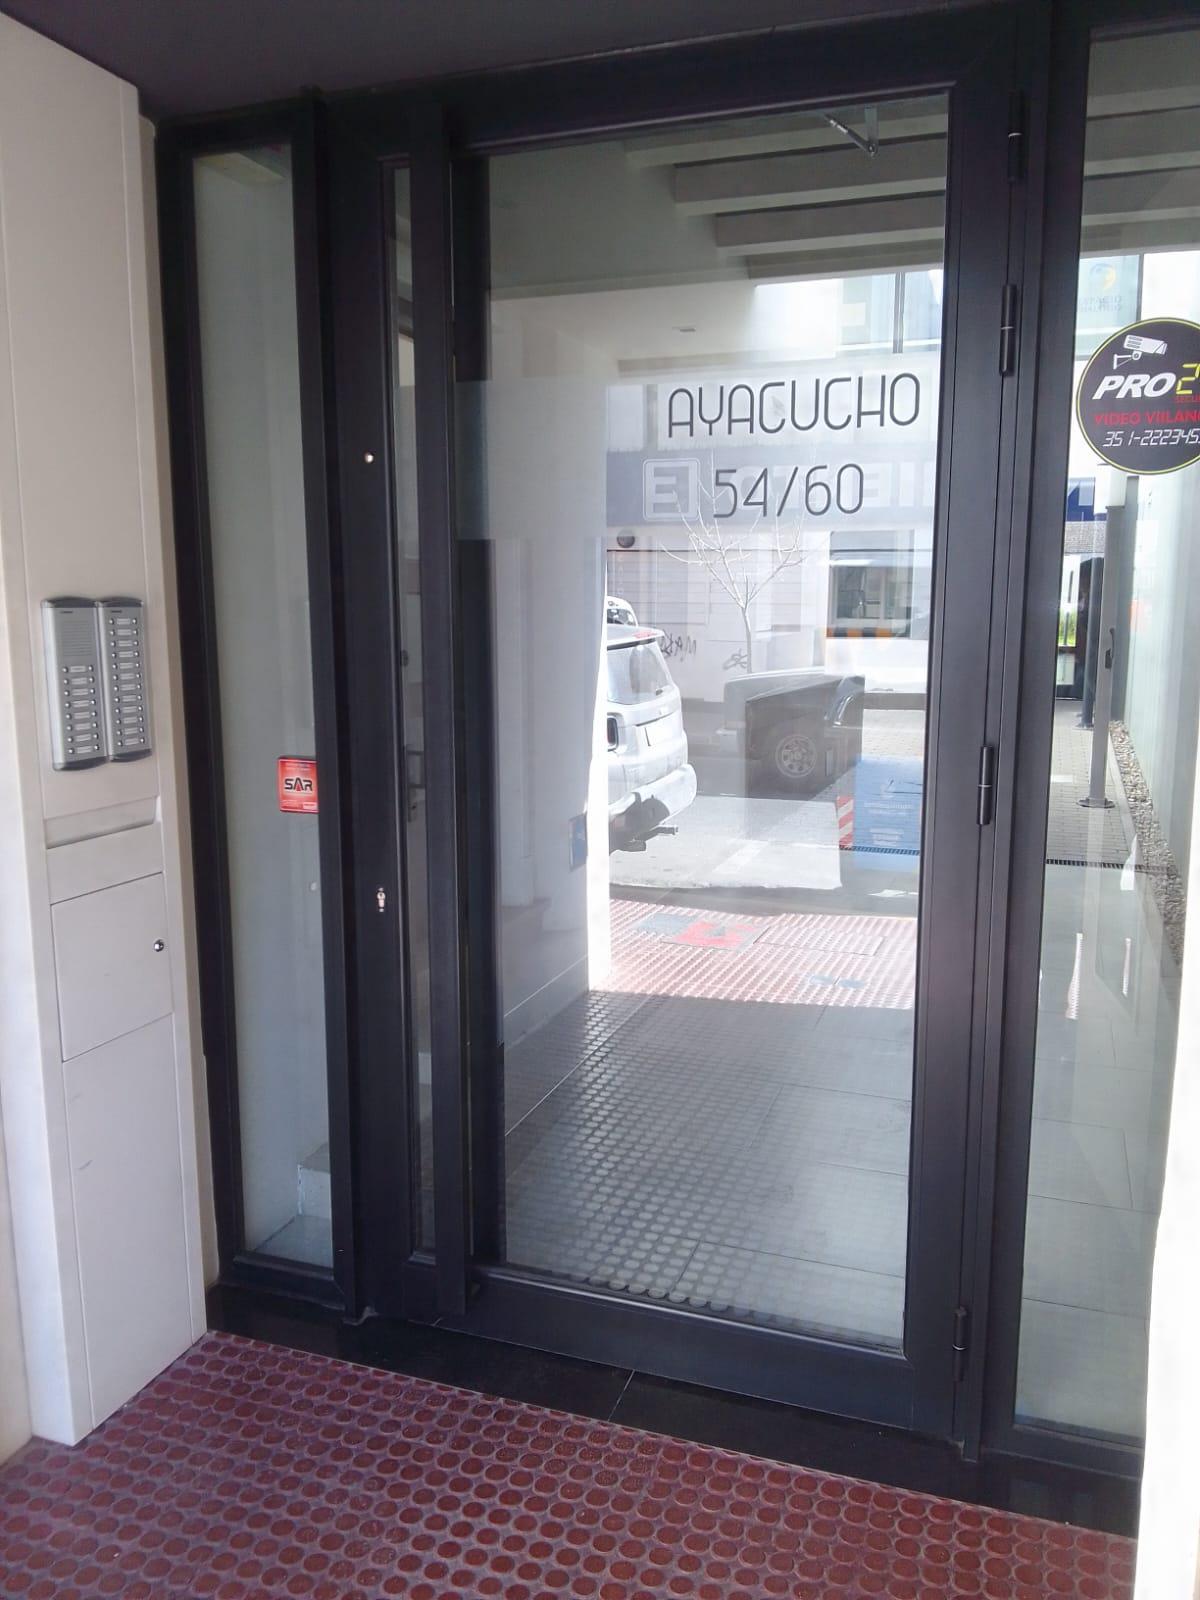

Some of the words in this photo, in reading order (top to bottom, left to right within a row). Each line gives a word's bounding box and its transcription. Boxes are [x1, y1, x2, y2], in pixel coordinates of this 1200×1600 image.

[668, 373, 921, 438] AYACUCHO
[1094, 410, 1141, 426] VIDEO
[713, 463, 864, 518] 54/60
[284, 777, 313, 792] SAR
